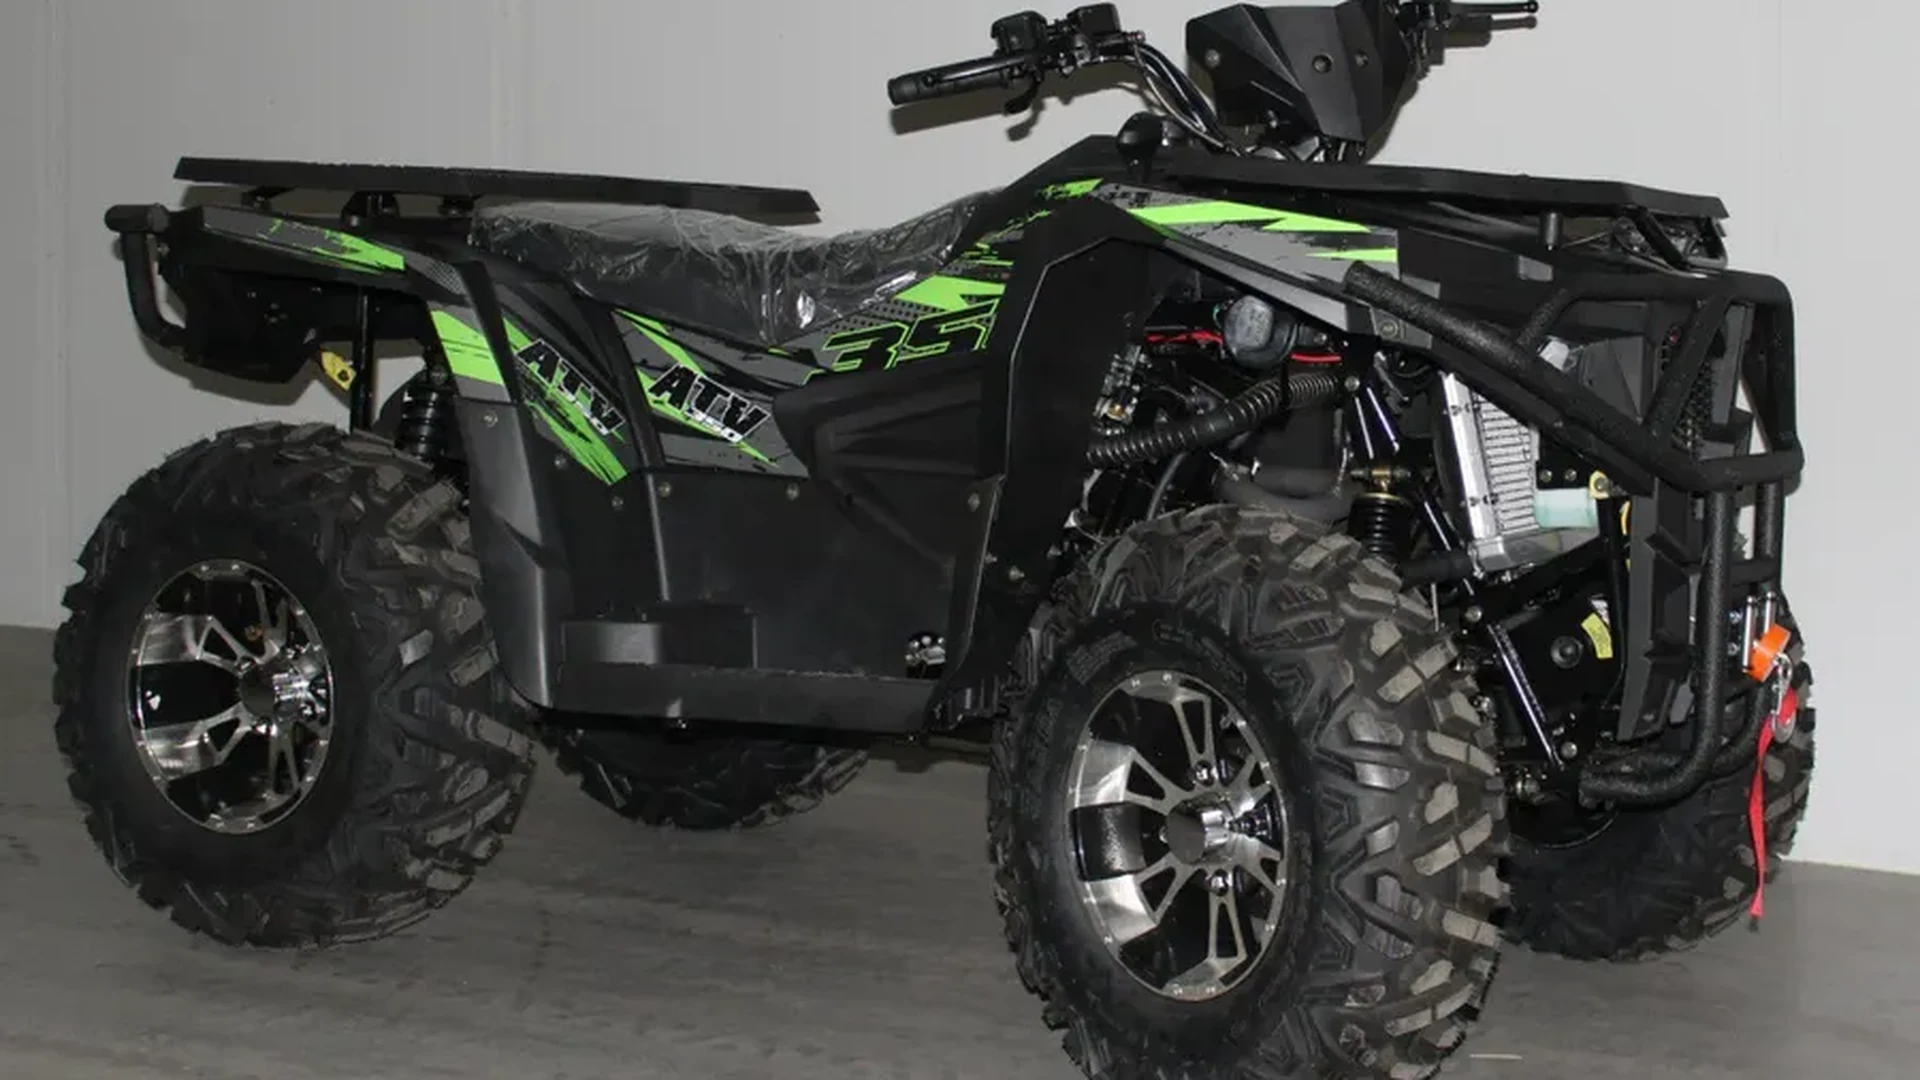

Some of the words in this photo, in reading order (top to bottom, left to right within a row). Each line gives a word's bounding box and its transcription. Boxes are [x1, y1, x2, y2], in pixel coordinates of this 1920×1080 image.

[822, 297, 1001, 371] 35
[515, 338, 627, 436] ATV
[648, 361, 772, 442] ATV
